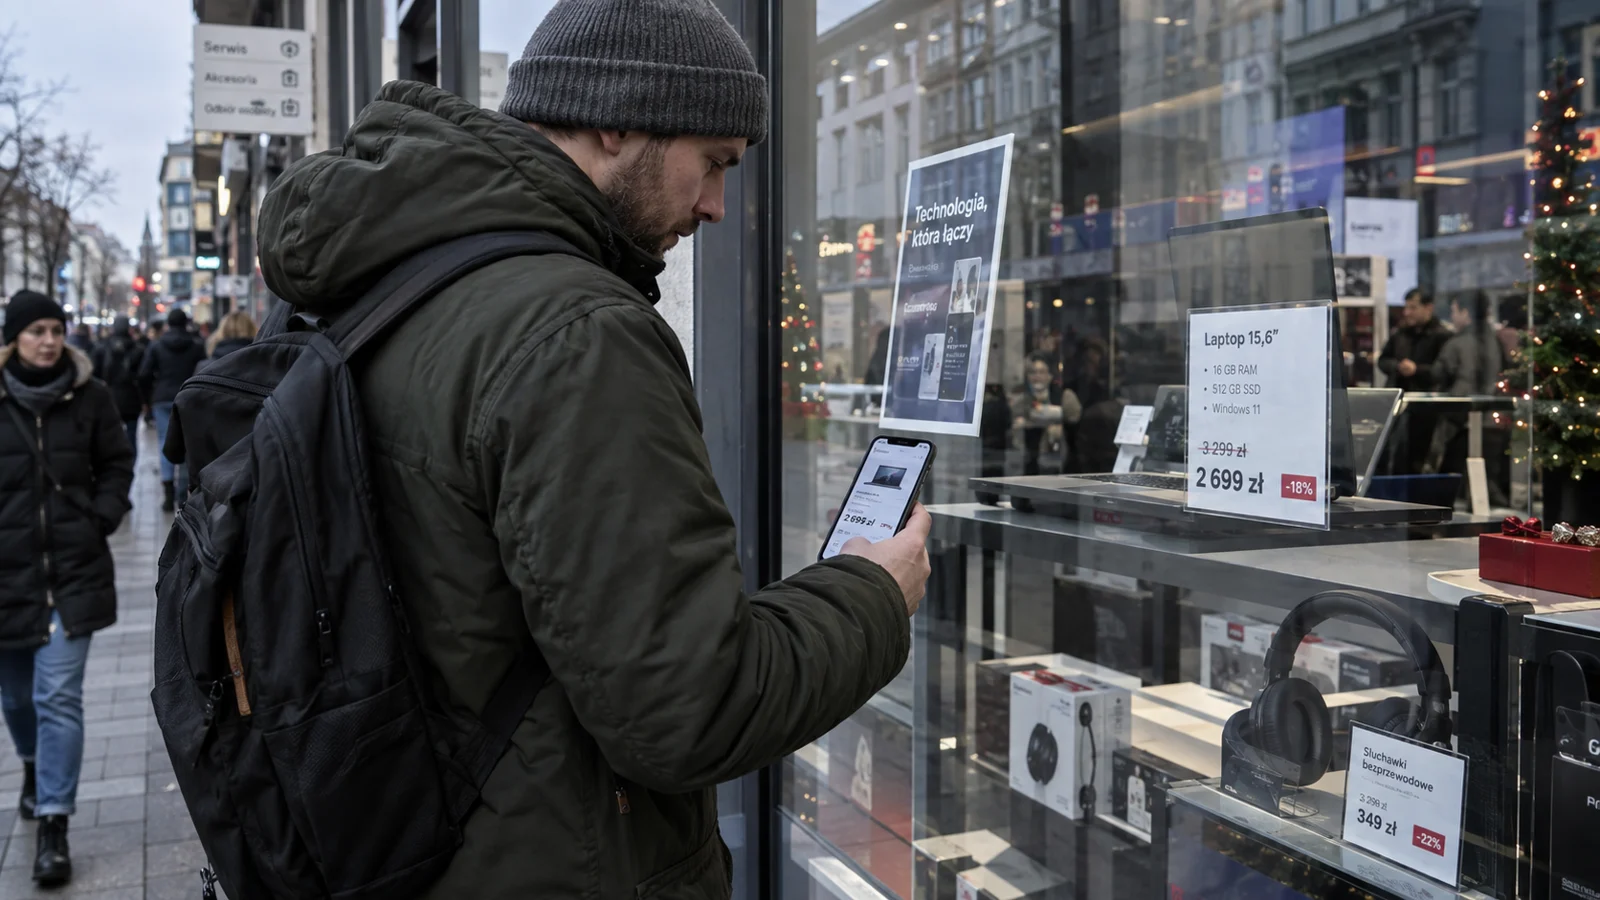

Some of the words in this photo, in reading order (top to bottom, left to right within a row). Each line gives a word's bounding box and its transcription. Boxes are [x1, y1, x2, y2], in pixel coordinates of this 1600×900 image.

[204, 41, 248, 54] Serwis
[915, 192, 988, 224] Technologia,
[911, 227, 940, 248] która
[942, 223, 974, 246] łączy
[1204, 332, 1245, 349] Laptop
[1213, 365, 1222, 375] 16
[1224, 364, 1236, 375] GB
[1238, 364, 1258, 375] RAM
[1212, 384, 1227, 395] 512
[1228, 384, 1241, 395] GB
[1243, 384, 1261, 395] SSD
[1212, 403, 1250, 415] Windows
[1252, 404, 1261, 415] 11
[1236, 443, 1247, 458] zł
[1248, 472, 1265, 494] zł
[1285, 480, 1313, 495] -18%
[1362, 758, 1434, 793] bezprzewodowe
[1357, 808, 1382, 830] 349
[1385, 820, 1398, 836] zł
[1416, 832, 1442, 851] -22%
